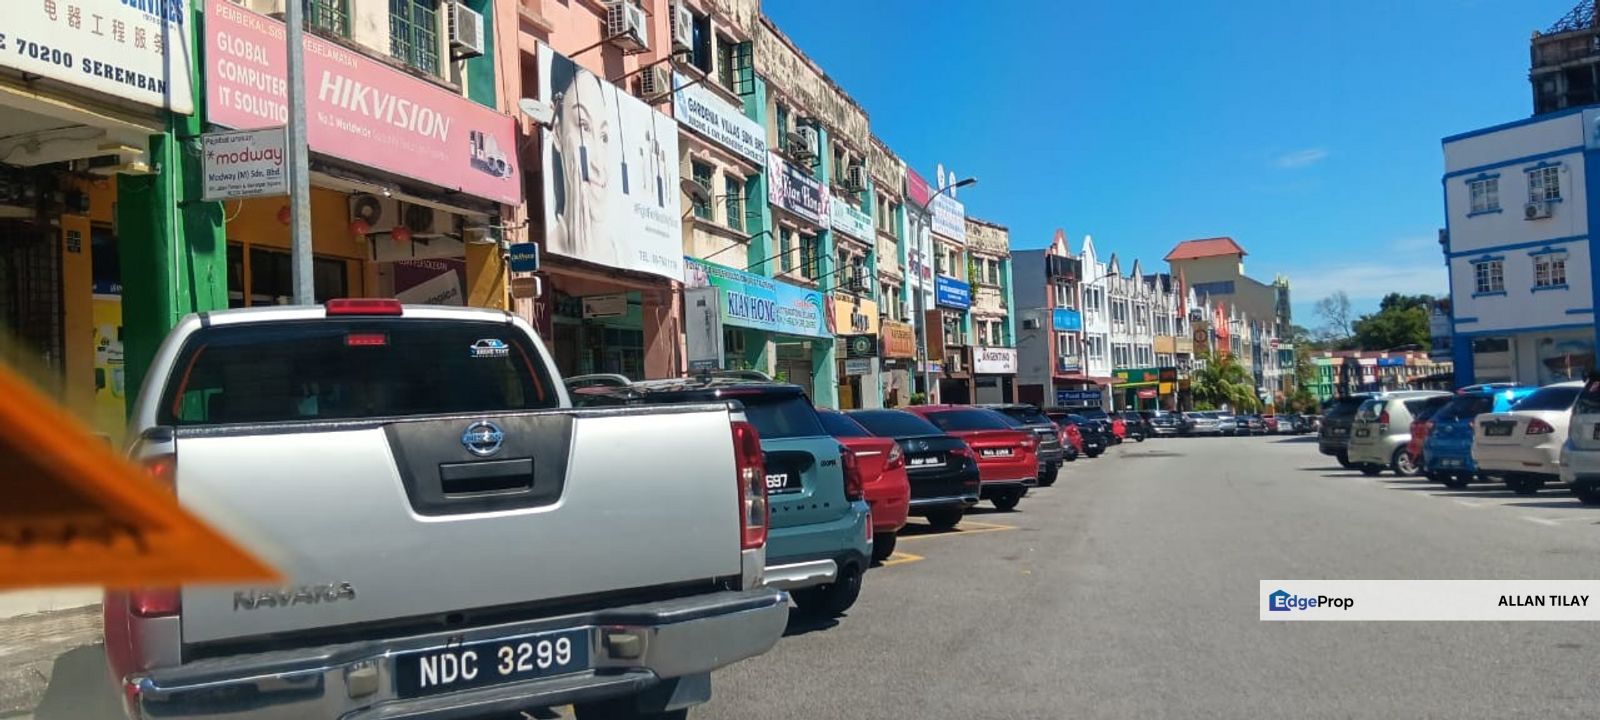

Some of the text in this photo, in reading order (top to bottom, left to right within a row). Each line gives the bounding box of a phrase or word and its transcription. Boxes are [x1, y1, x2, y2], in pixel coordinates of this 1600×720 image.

[16, 38, 73, 69] 70200
[82, 57, 168, 95] SEREMBAN
[217, 31, 269, 67] GLOBAL
[217, 58, 288, 98] COMPUTER
[218, 87, 288, 124] IT SOLUTIO
[318, 70, 451, 143] HIKVISION
[687, 97, 720, 127] GARDENIA
[721, 117, 740, 139] VILLAS
[216, 146, 283, 166] modway
[728, 291, 750, 318] KIAN
[234, 582, 356, 611] NAVARA
[419, 637, 573, 688] NDC 3299
